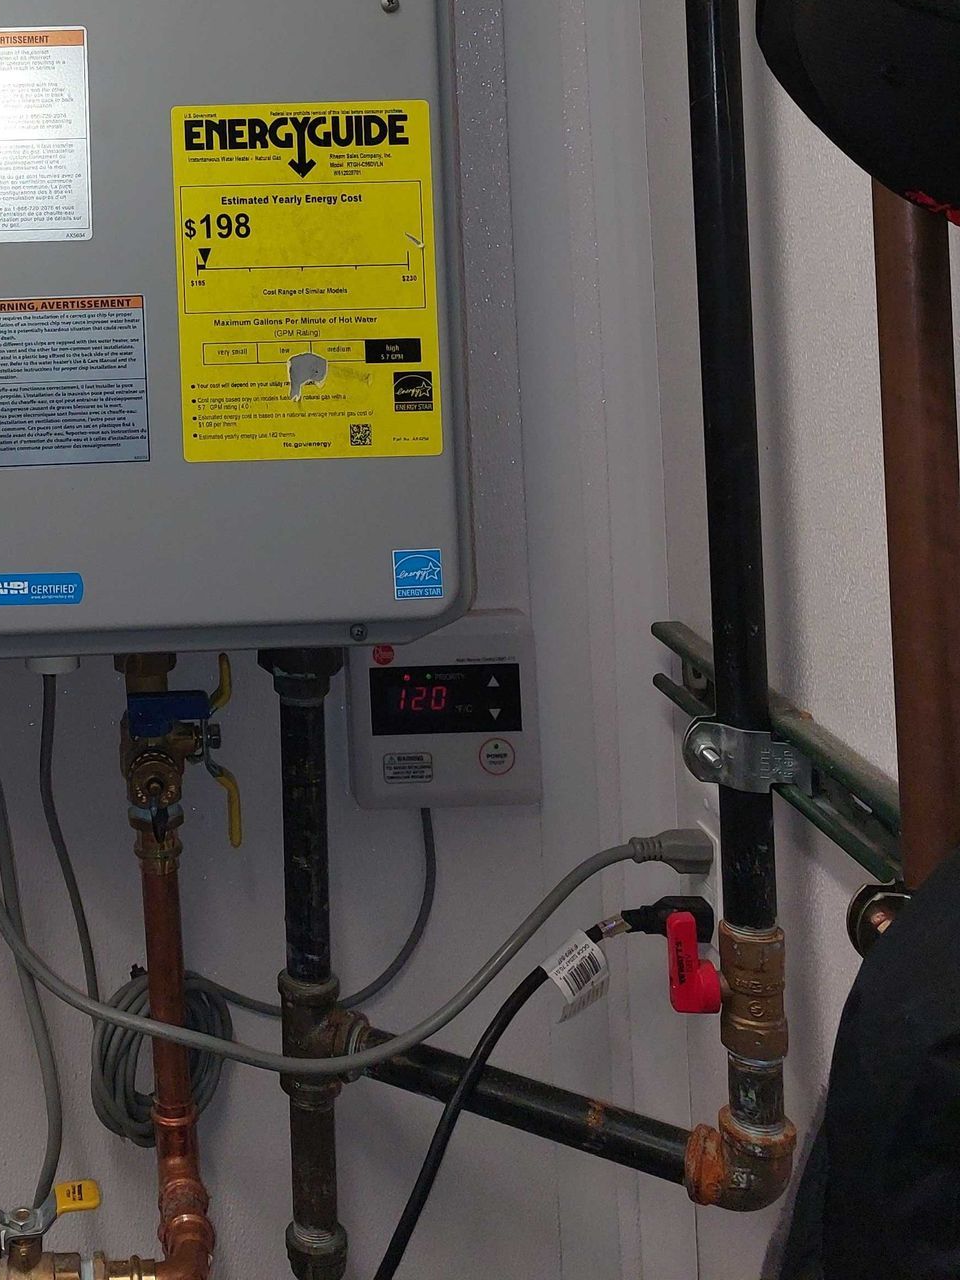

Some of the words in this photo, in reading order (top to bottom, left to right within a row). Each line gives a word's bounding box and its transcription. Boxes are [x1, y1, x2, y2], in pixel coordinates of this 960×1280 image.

[184, 114, 409, 151] ENERGYGUIDE
[221, 196, 269, 205] Estimated
[272, 195, 302, 206] Yearly
[305, 195, 338, 206] Energy
[341, 194, 362, 202] Cost
[185, 213, 251, 240] $198
[41, 299, 131, 309] AVERTISSEMENT
[214, 319, 251, 327] Maximum
[253, 318, 282, 326] Gallons
[329, 316, 337, 324] of
[355, 315, 377, 323] Water
[400, 686, 448, 710] 120
